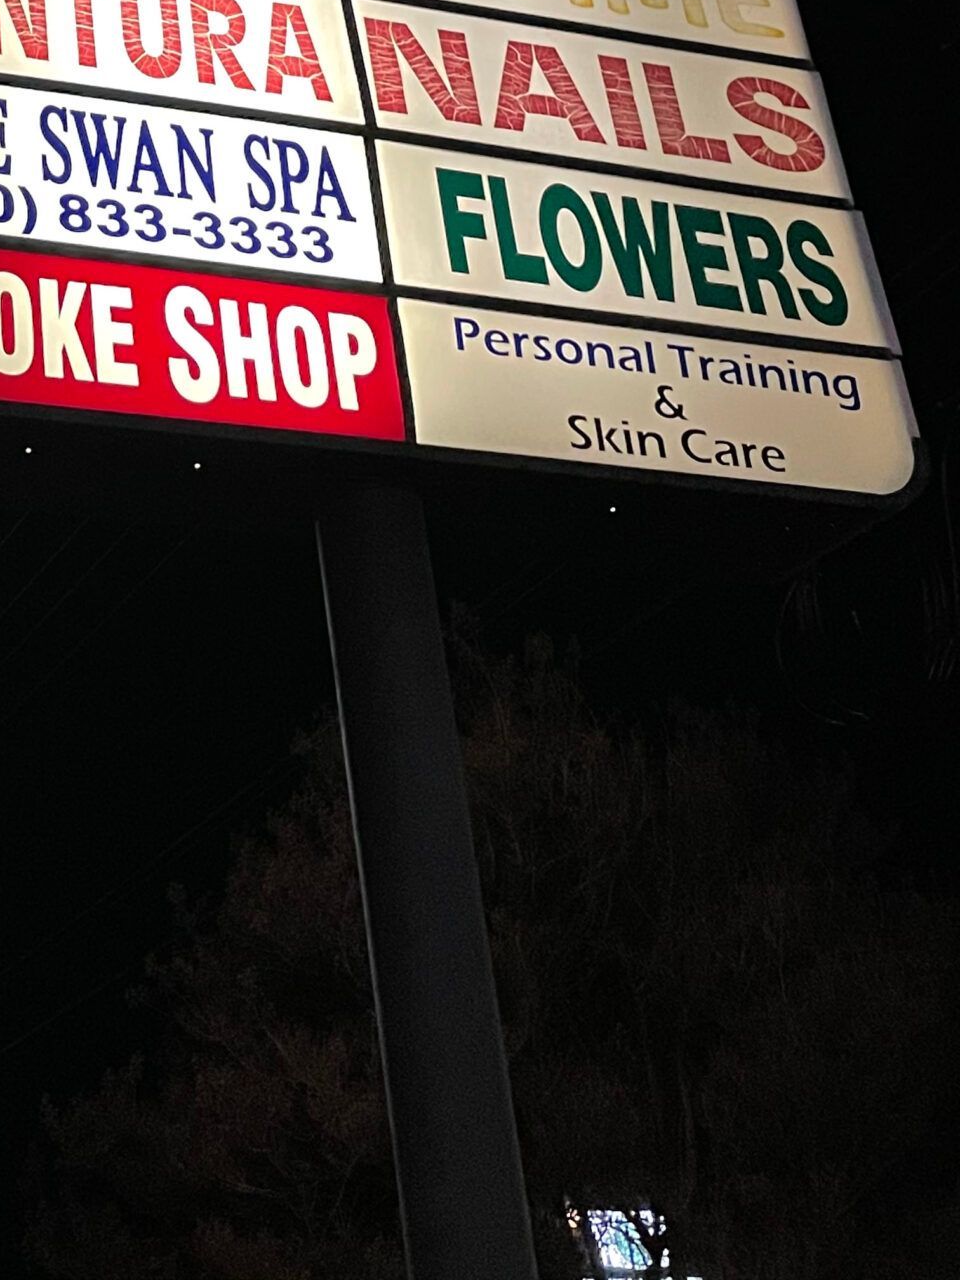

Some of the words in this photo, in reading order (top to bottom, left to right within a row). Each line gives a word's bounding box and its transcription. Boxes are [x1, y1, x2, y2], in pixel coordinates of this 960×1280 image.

[363, 16, 825, 173] NAILS
[40, 105, 218, 204] SWAN
[243, 135, 357, 223] SPA
[59, 193, 334, 264] 833-3333
[436, 167, 848, 326] FLOWERS
[165, 285, 377, 411] SHOP
[453, 317, 657, 374] Personal
[668, 344, 859, 410] Training
[568, 414, 666, 459] Skin
[682, 429, 786, 472] Care
[654, 385, 688, 420] &
